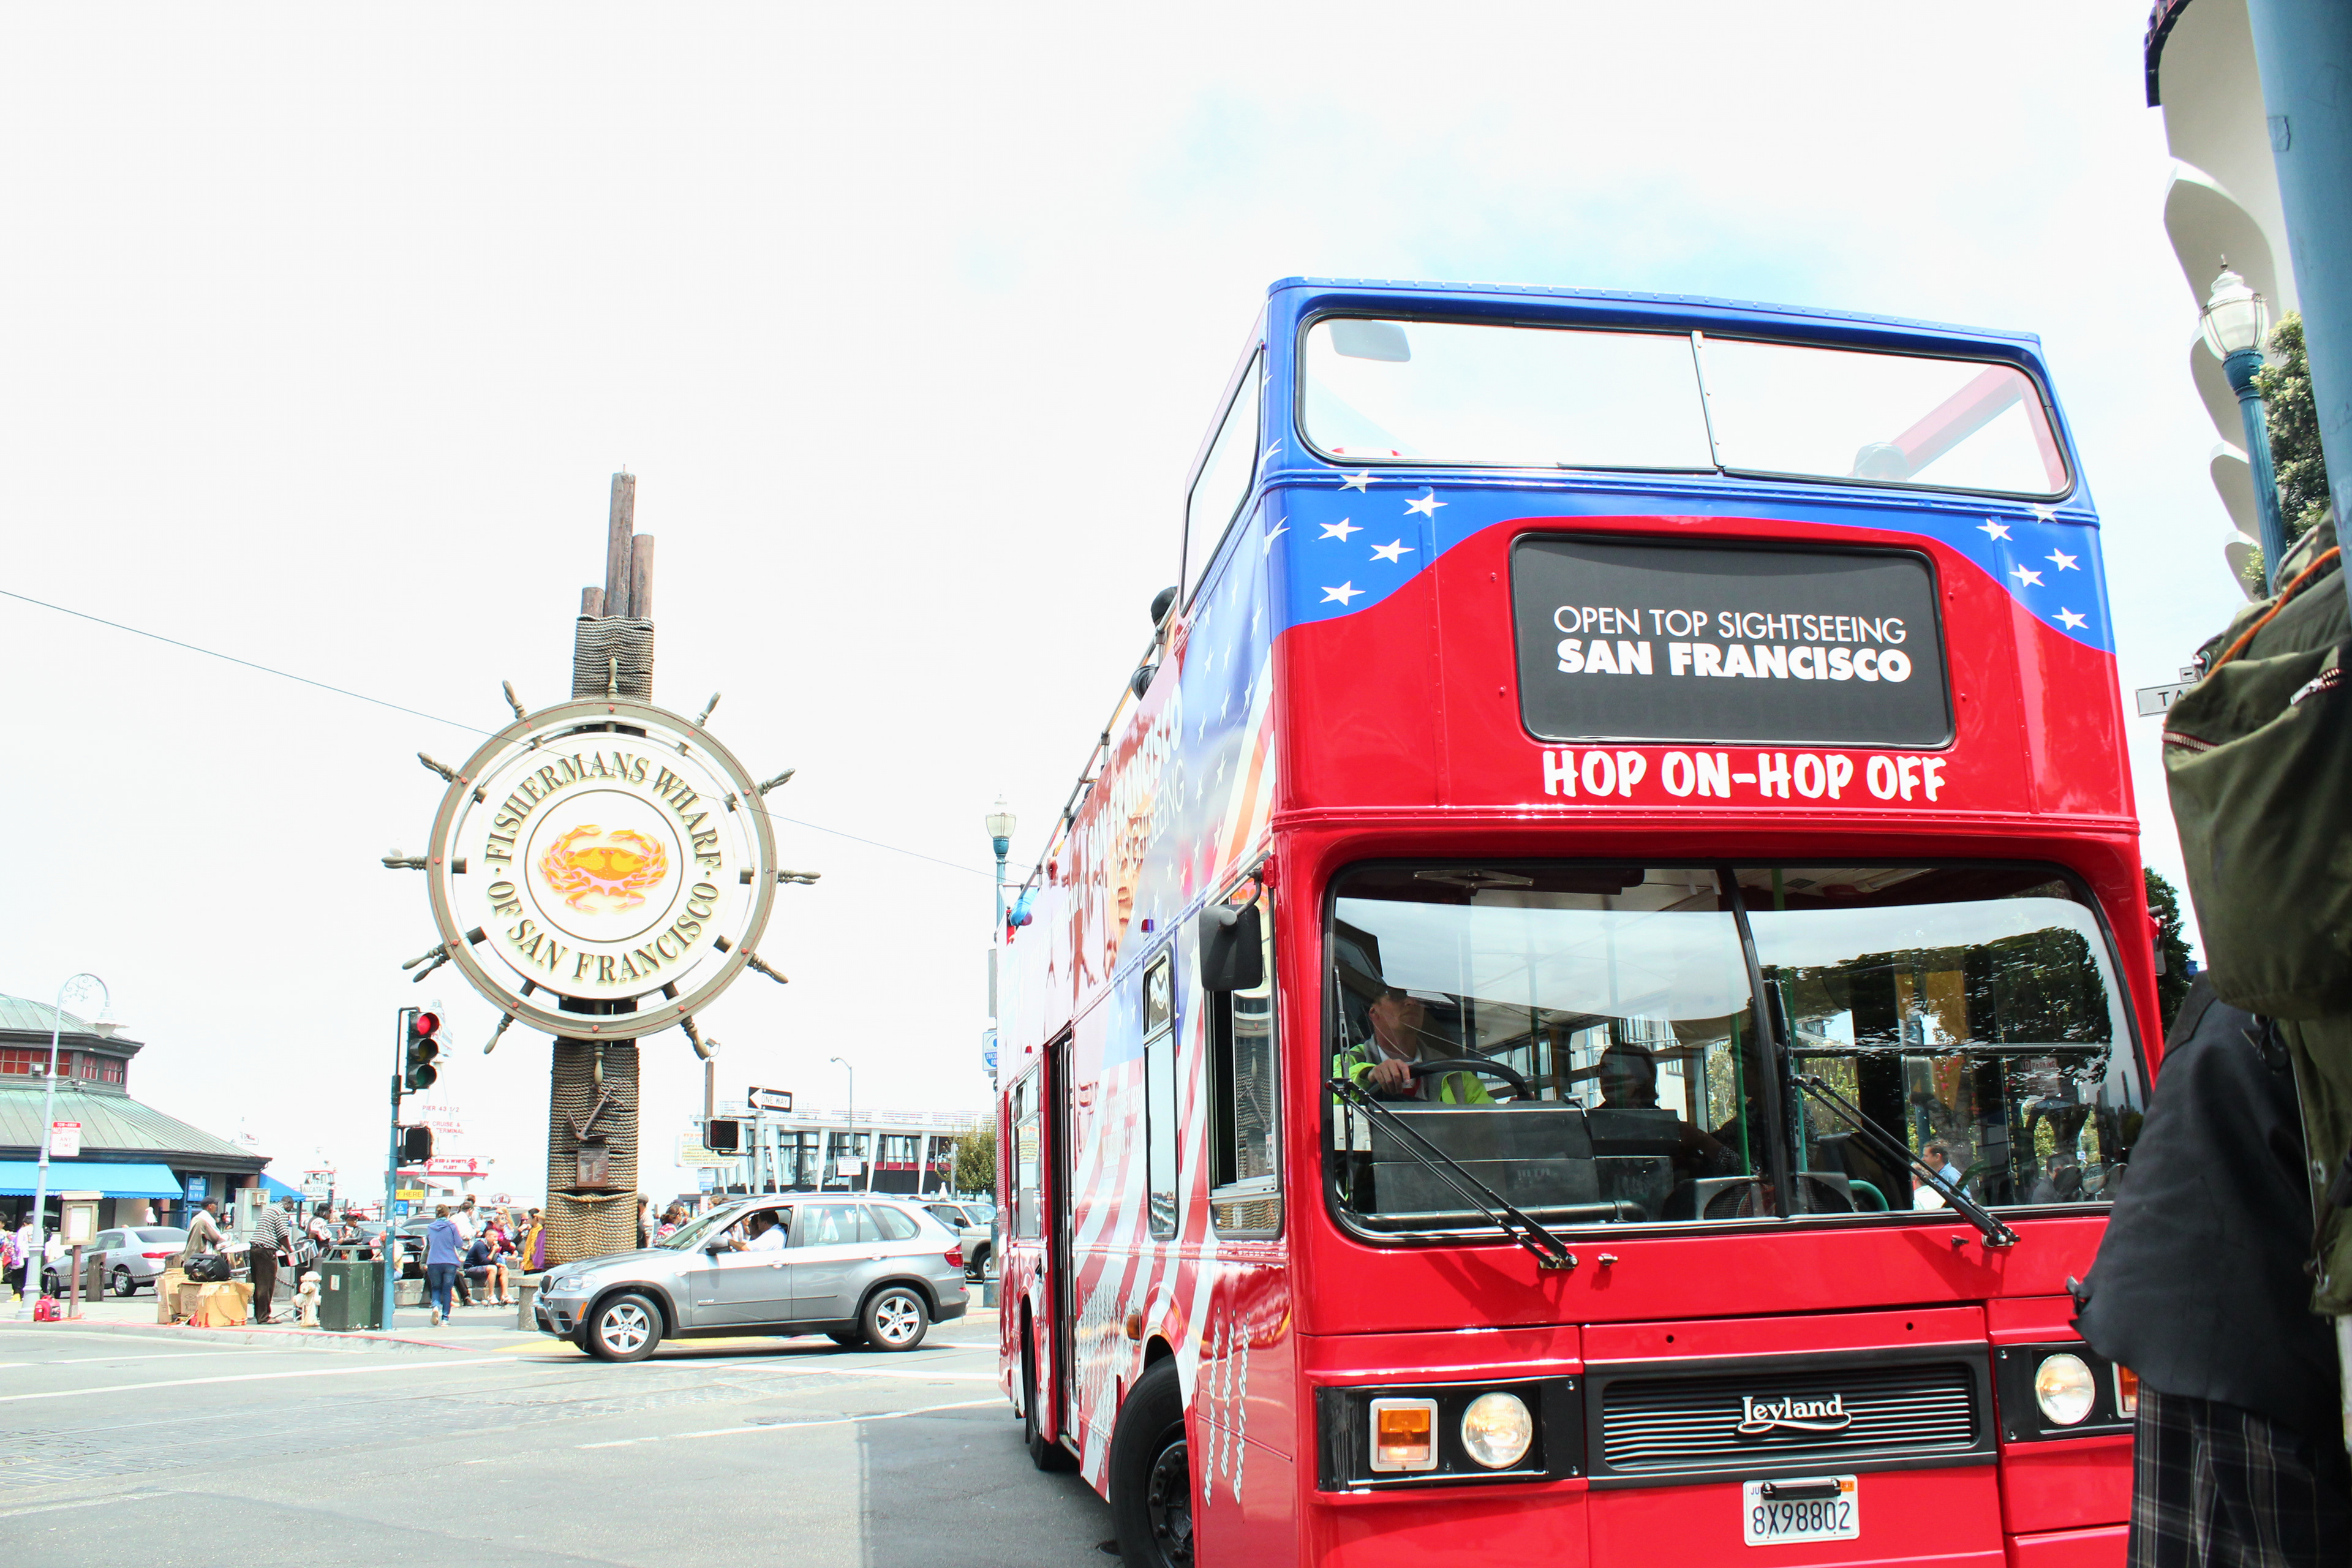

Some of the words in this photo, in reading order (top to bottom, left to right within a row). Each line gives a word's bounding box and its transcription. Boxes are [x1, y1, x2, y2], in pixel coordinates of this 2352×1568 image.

[1553, 605, 1639, 636] OPEN
[1648, 608, 1708, 636] TOP
[1718, 611, 1907, 644] SIGHTSEEING
[1557, 639, 1653, 675] SAN
[1669, 642, 1912, 682] FRANCISCO
[2157, 688, 2189, 706] TA
[484, 750, 650, 865] FISHERMANS
[652, 765, 722, 869] WHARF
[1088, 801, 1107, 877] SAN
[1110, 682, 1183, 843] FRANCISCO
[1542, 750, 1647, 797] HOP
[1661, 752, 1854, 799] ON-HOP
[1866, 755, 1947, 802] OFF
[1107, 845, 1123, 900] TOP
[1124, 758, 1185, 880] SIGHTSEEING
[487, 880, 524, 918] OF
[506, 918, 568, 971] SAN
[572, 881, 718, 982] FRANCISCO
[761, 1095, 773, 1104] ONE
[775, 1096, 788, 1106] WAY
[1208, 1320, 1220, 1400] Center
[1223, 1322, 1235, 1408] Square
[1238, 1322, 1250, 1398] Coast
[1221, 1409, 1231, 1479] Union
[1738, 1393, 1851, 1432] Leyland
[1204, 1402, 1216, 1507] Moscone
[1233, 1398, 1246, 1505] Barbary
[1752, 1501, 1852, 1535] 8X98802
